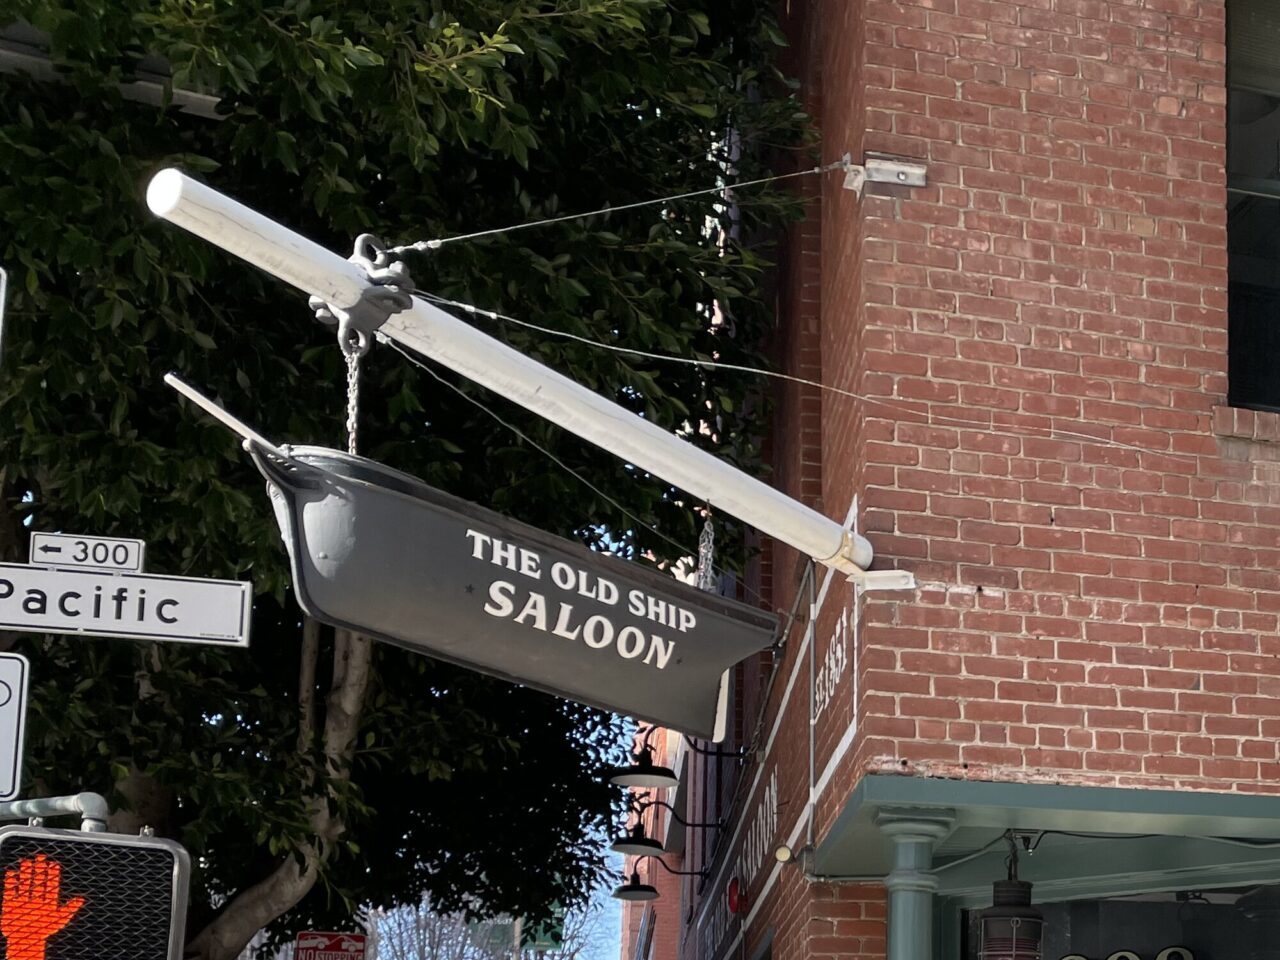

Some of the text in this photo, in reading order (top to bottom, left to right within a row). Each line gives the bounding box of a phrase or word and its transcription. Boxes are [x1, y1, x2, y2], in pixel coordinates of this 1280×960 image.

[72, 540, 129, 566] 300
[465, 529, 697, 633] THE OLD SHIP
[484, 580, 675, 670] SALOON
[824, 606, 848, 710] 1851
[742, 762, 778, 896] SALOON
